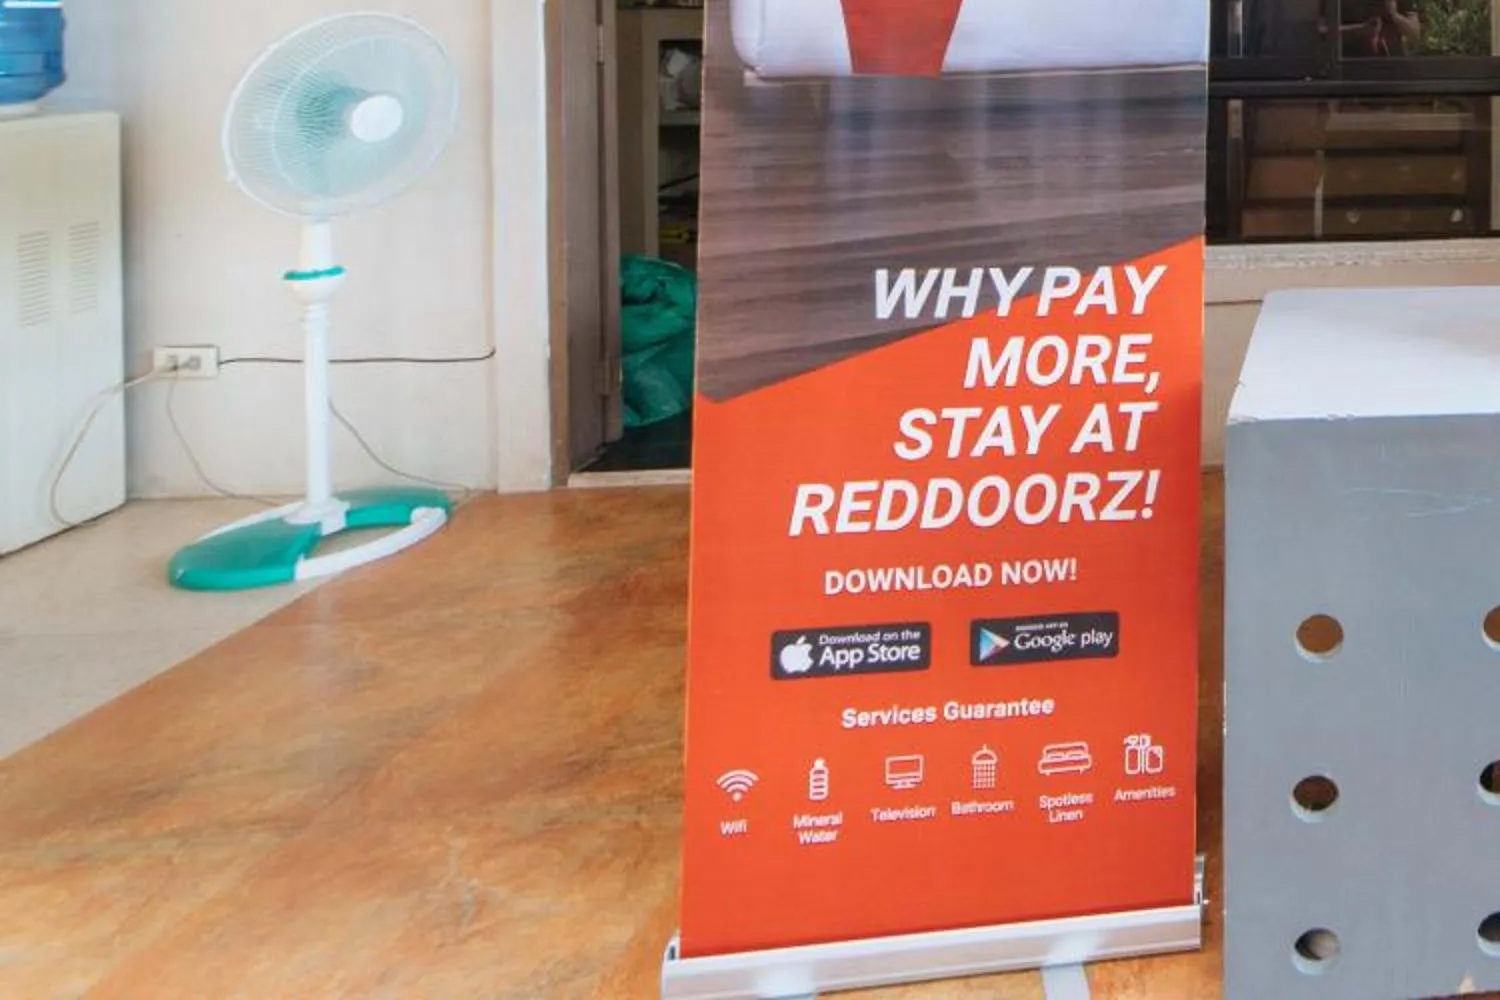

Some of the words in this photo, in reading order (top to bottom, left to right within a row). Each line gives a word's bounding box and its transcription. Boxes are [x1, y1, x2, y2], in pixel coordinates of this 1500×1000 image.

[874, 267, 1032, 320] WHY
[1036, 264, 1167, 318] PAY
[963, 333, 1160, 394] MORE,
[893, 404, 1062, 461] STAY
[1069, 401, 1159, 454] AT
[788, 469, 1161, 537] REDDOORZ!
[823, 562, 993, 595] DOWNLOAD
[1001, 557, 1078, 584] NOW!
[819, 631, 881, 646] Download
[883, 633, 898, 642] on
[901, 629, 921, 640] the
[1014, 629, 1076, 653] Google
[1080, 627, 1114, 649] play
[819, 645, 864, 669] App
[867, 643, 921, 663] Store
[841, 705, 937, 728] Services
[943, 698, 1055, 721] Guarantee
[1039, 792, 1094, 810] Spotless
[1114, 785, 1176, 801] Amenities
[871, 804, 937, 822] Television
[951, 800, 1014, 816] Bathroom
[1049, 808, 1084, 824] Linen
[720, 819, 747, 836] Wifi
[793, 812, 843, 829] Mineral
[798, 829, 839, 845] Water
